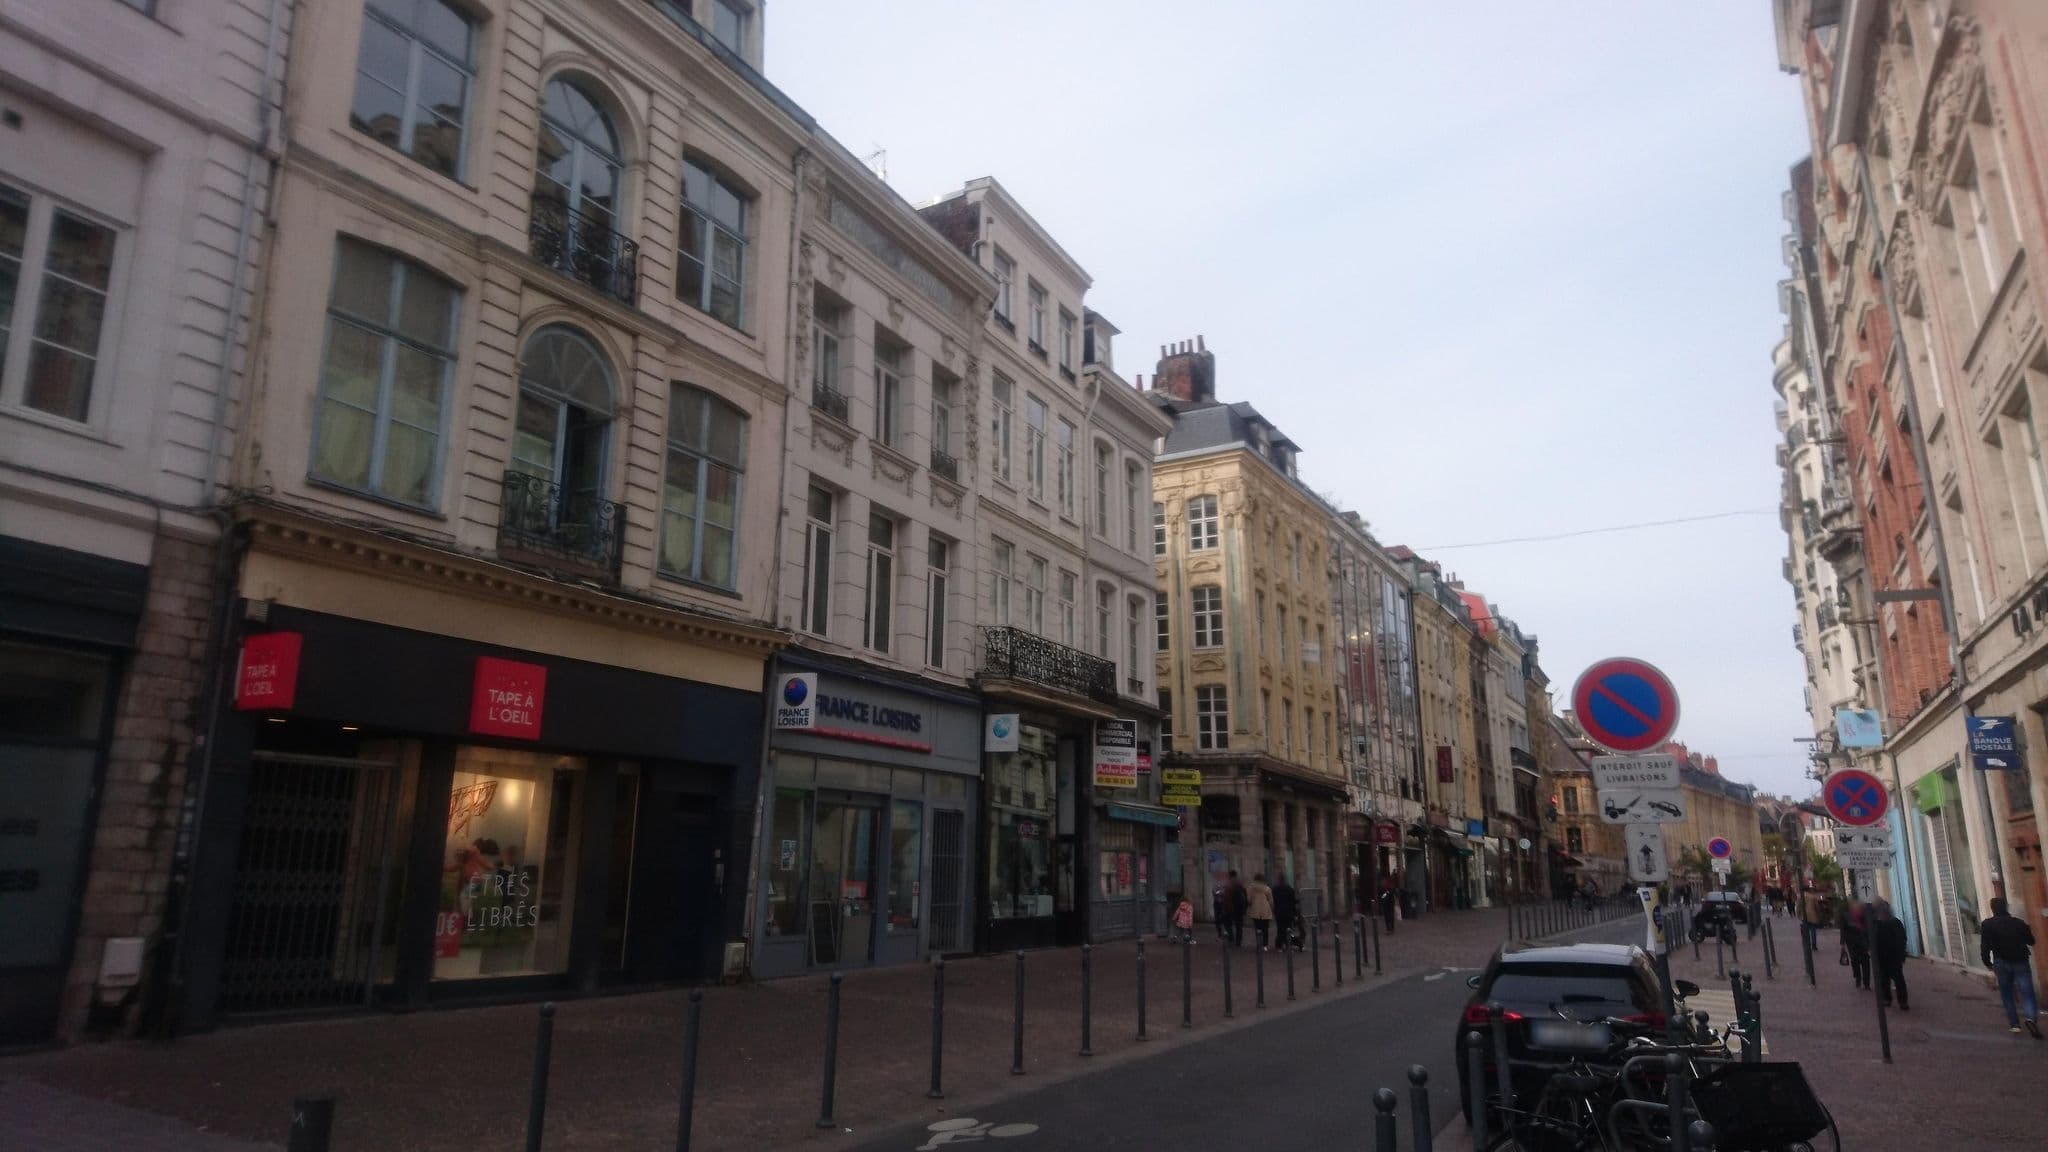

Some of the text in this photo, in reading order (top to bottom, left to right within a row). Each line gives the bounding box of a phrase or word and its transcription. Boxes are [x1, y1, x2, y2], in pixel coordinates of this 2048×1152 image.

[247, 664, 270, 678] TAPE
[245, 681, 273, 696] L'OEIL
[488, 688, 522, 707] TAPE
[488, 707, 533, 725] L'OEIL
[778, 708, 809, 717] FRANCE
[873, 705, 922, 732] LOISIRS
[778, 717, 809, 726] LOISIRS
[1596, 761, 1673, 771] INTERDIT SAUF
[1606, 773, 1667, 783] LIVRAISONS
